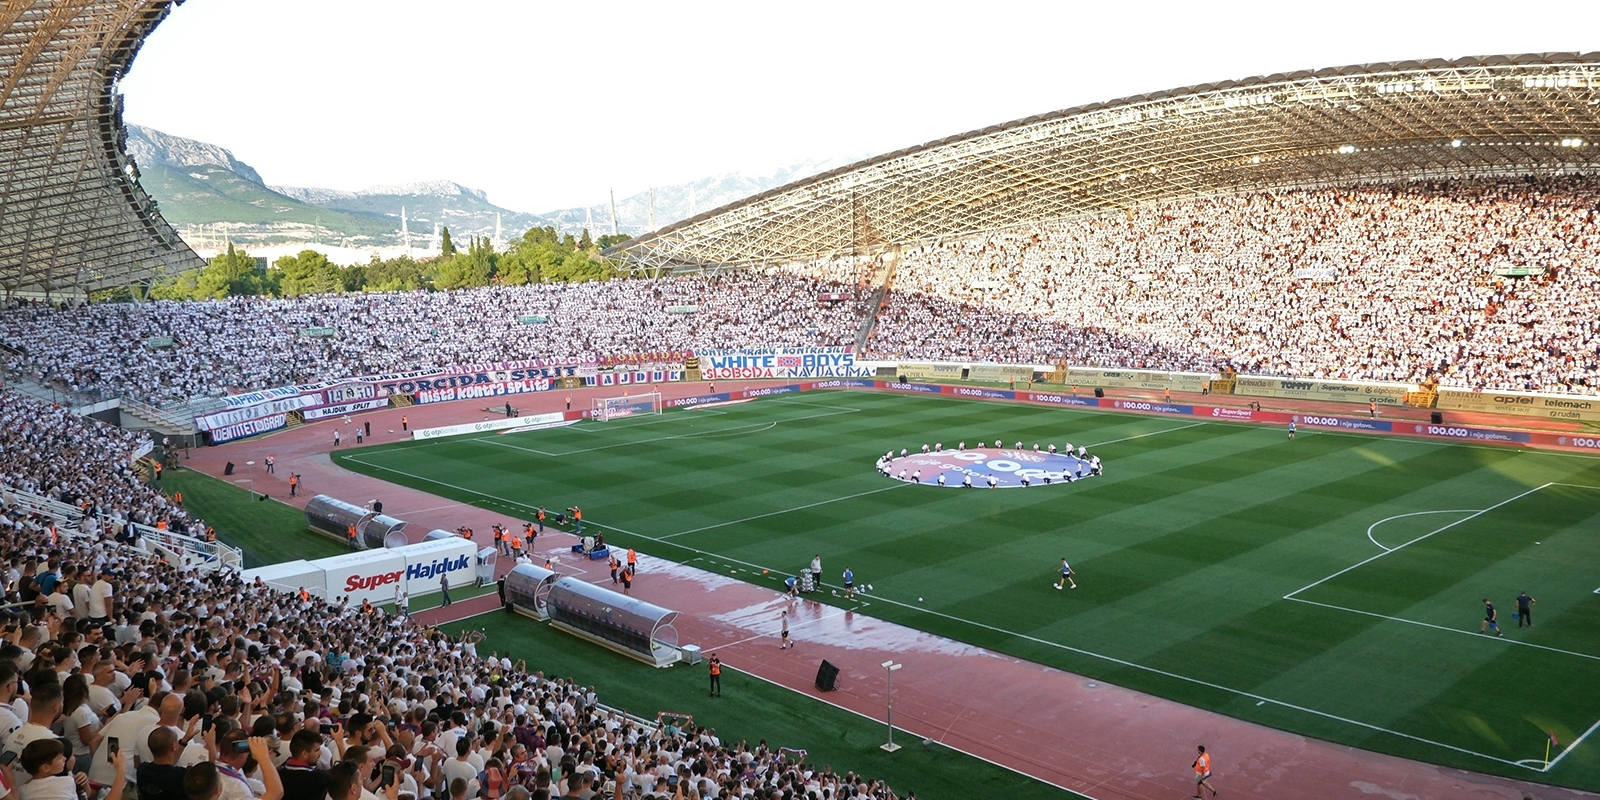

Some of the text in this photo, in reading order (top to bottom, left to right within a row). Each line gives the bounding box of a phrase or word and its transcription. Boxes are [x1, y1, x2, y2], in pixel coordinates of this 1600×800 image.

[607, 352, 682, 365] TORCIDA
[710, 356, 775, 368] WHITE
[803, 354, 854, 366] BOYS
[444, 362, 504, 375] HAJDUK
[706, 368, 774, 379] SLOBODA
[382, 373, 492, 394] TORCIDA
[511, 366, 578, 380] SPLIT
[586, 371, 680, 385] HAJDUK
[1238, 380, 1267, 388] Karlovačko
[1280, 382, 1314, 390] TOMMY
[1321, 384, 1360, 392] SuperSport
[1445, 392, 1484, 400] ADRIATIC
[1494, 396, 1534, 404] apfel
[264, 404, 268, 414] S
[322, 402, 370, 415] HAJDUK SPLIT
[1545, 400, 1592, 410] telemach
[1221, 408, 1252, 416] SuperSport
[1557, 410, 1581, 418] rudan
[212, 421, 255, 442] IDENTITET
[431, 427, 458, 436] otpbanka
[344, 554, 471, 592] Super Hajduk
